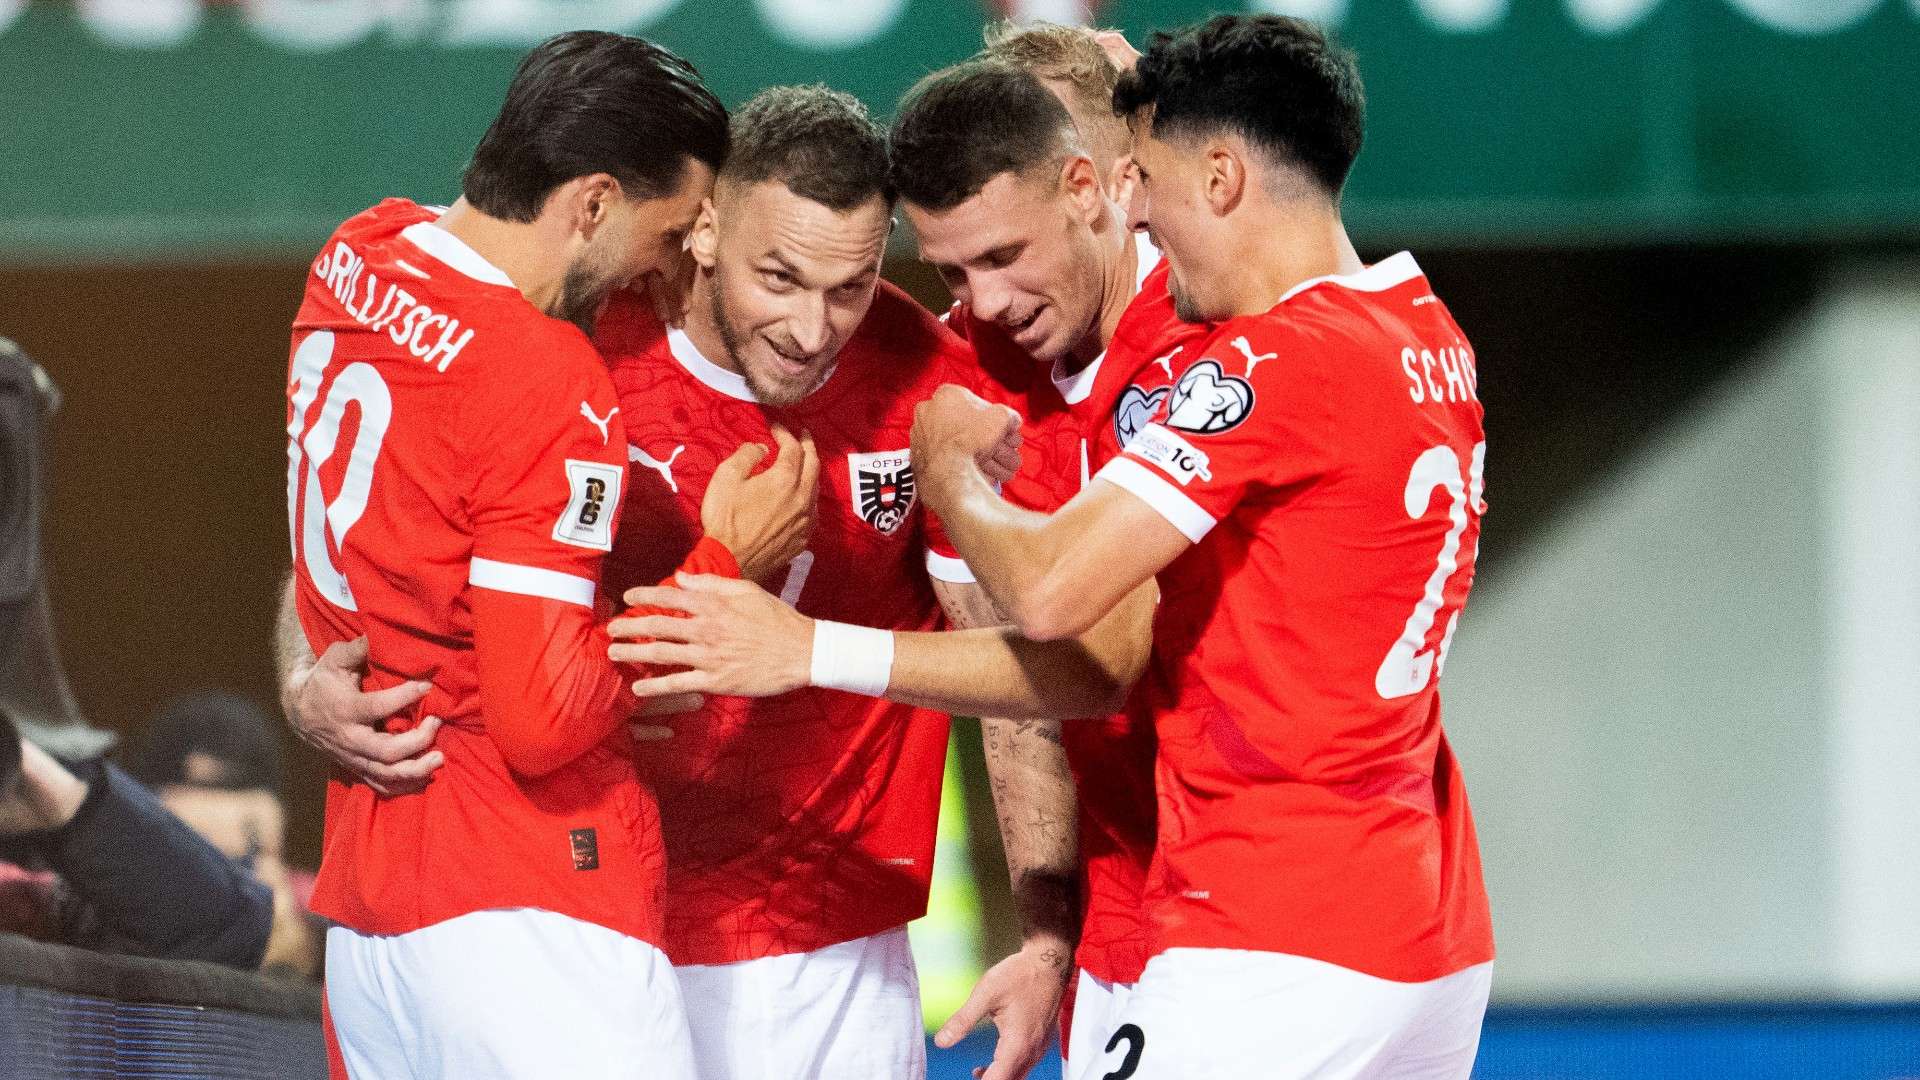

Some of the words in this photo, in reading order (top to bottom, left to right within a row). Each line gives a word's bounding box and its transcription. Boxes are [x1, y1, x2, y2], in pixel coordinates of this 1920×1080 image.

[872, 458, 902, 468] ÖFB
[1375, 443, 1486, 699] 2
[1102, 1023, 1145, 1080] 2
